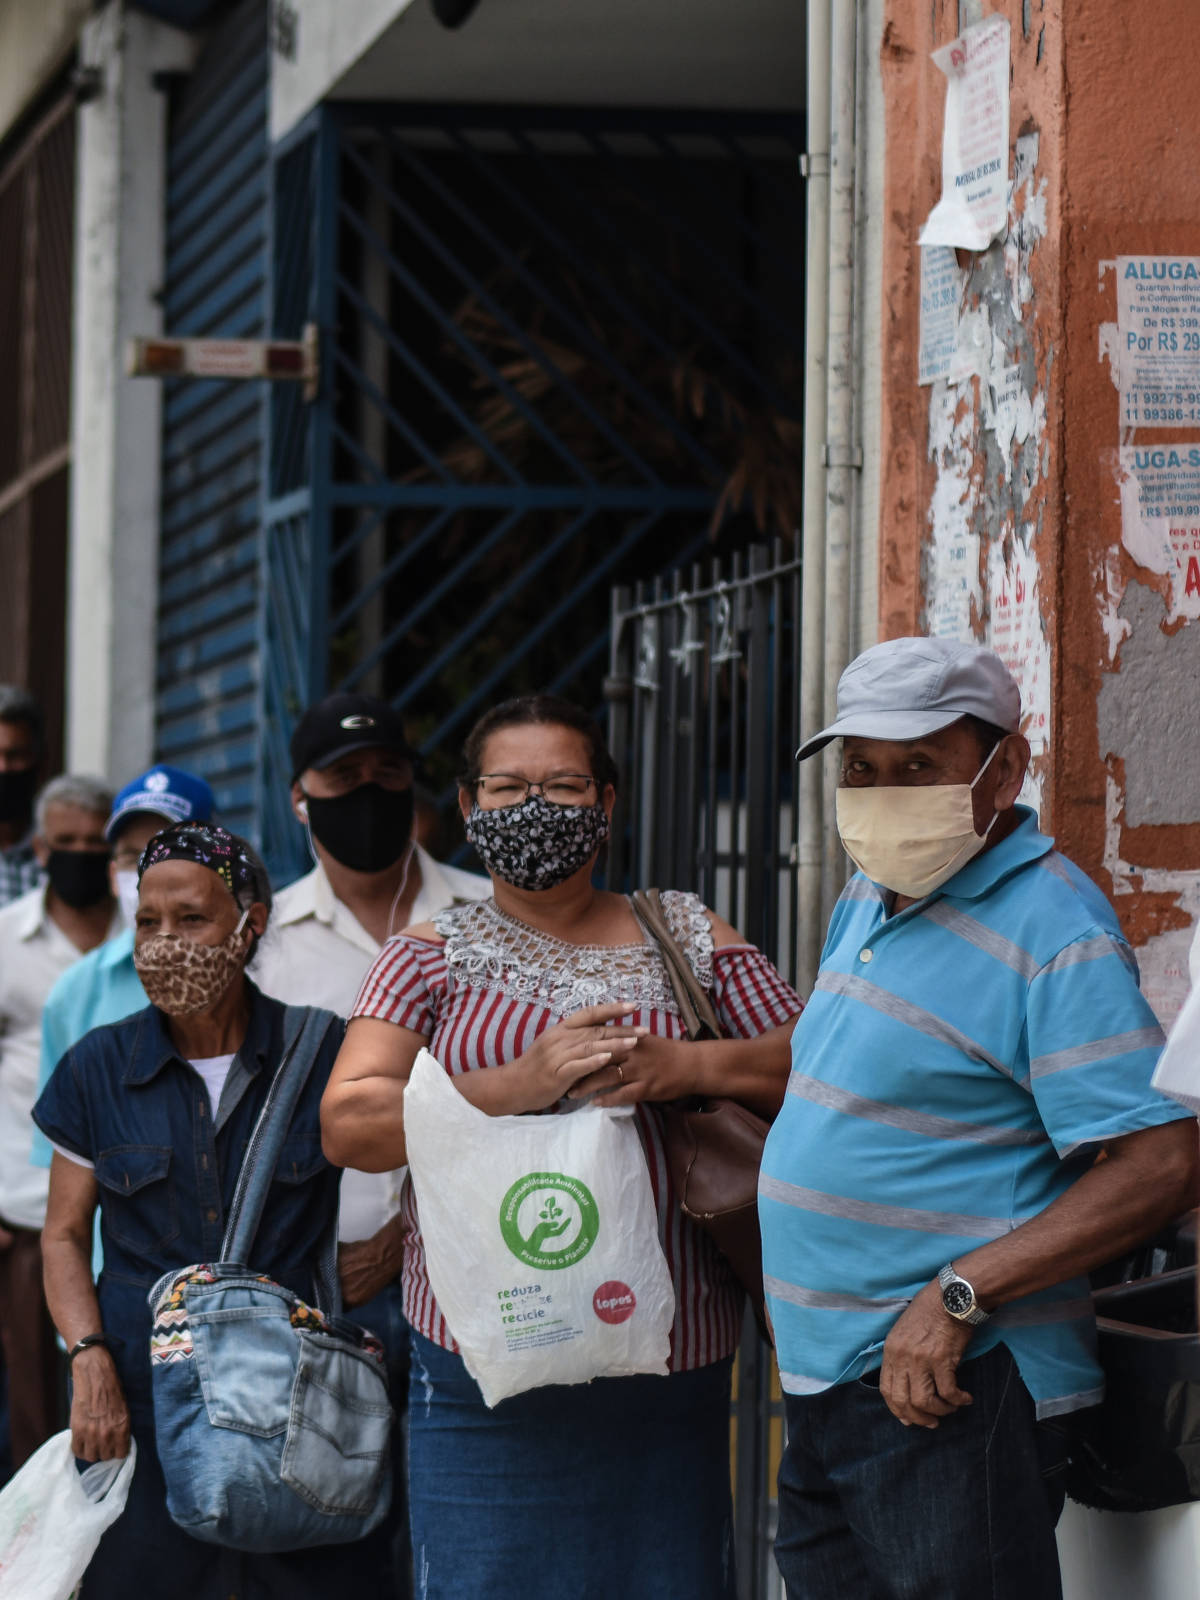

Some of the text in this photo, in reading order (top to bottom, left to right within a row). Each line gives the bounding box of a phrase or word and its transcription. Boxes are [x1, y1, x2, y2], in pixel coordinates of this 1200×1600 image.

[1143, 318, 1158, 328] De
[1161, 318, 1176, 329] R$
[1127, 332, 1153, 351] Por
[1158, 331, 1178, 352] R$
[1126, 392, 1138, 404] 11
[1126, 408, 1138, 420] 11
[1130, 450, 1200, 469] UGA-S
[1146, 506, 1161, 517] R$
[1191, 528, 1200, 538] q
[521, 1249, 557, 1265] Preserve
[497, 1284, 542, 1300] reduza
